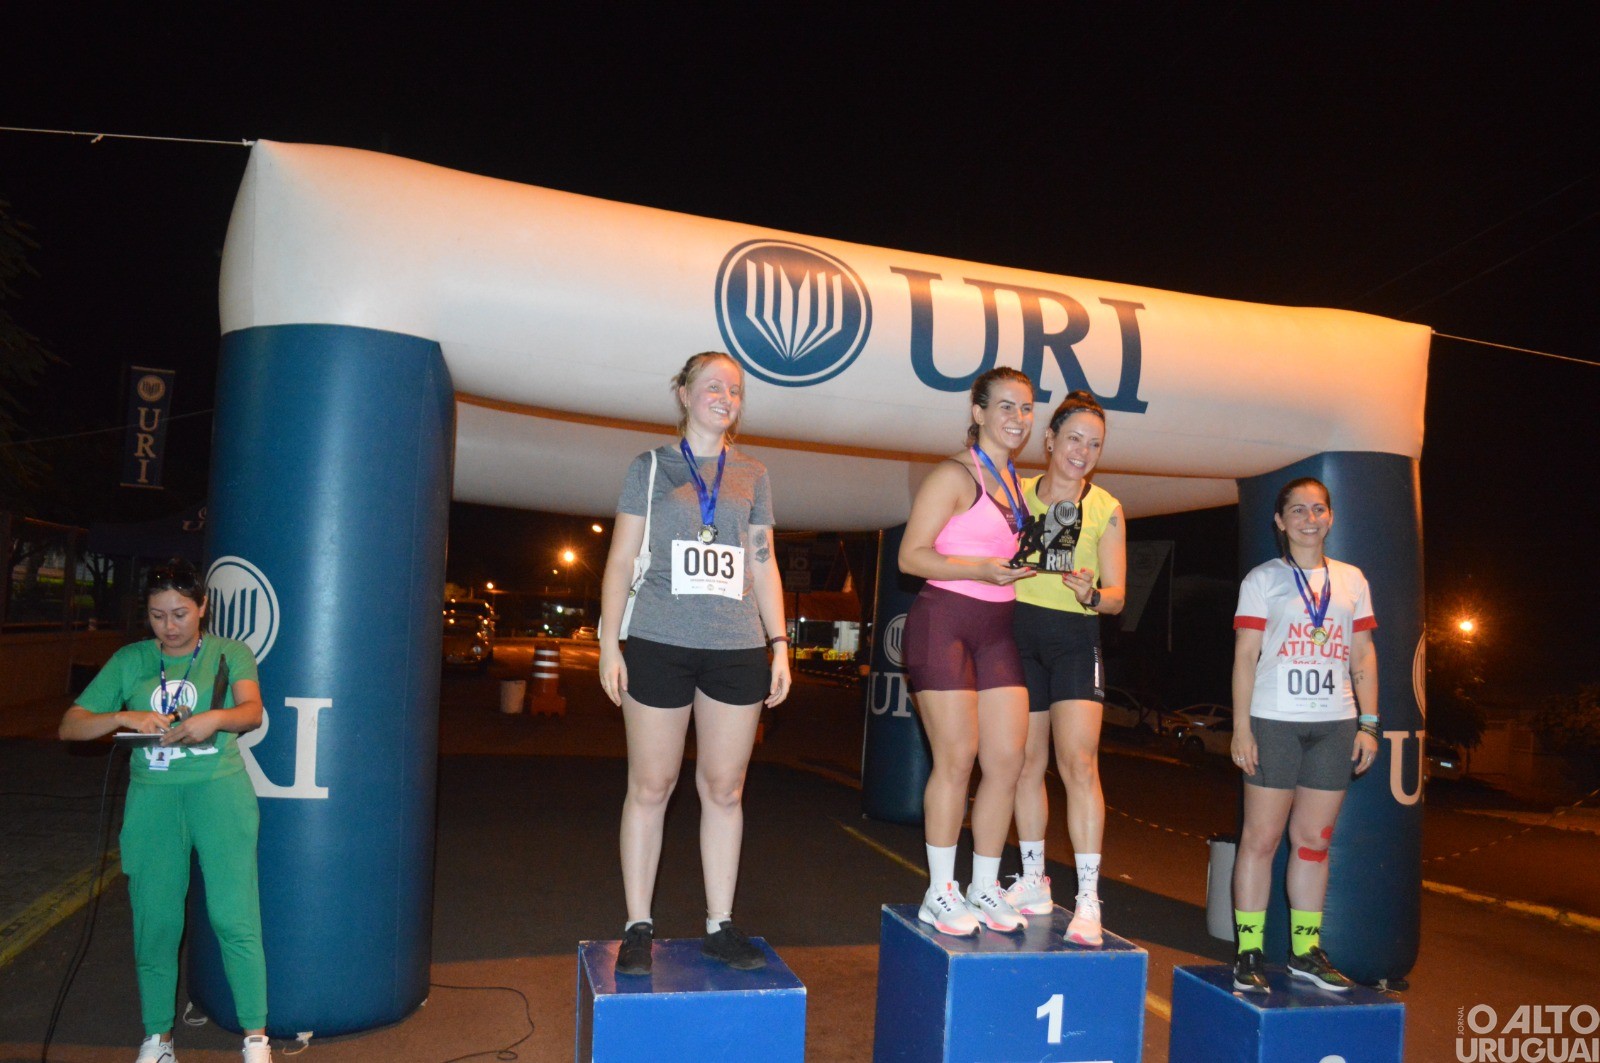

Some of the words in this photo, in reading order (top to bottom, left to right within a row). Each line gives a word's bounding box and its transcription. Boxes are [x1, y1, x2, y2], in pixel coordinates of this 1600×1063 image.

[890, 266, 1148, 414] URI
[134, 407, 162, 483] URI
[684, 547, 734, 579] 003
[1277, 641, 1350, 661] ATITUDE
[1287, 669, 1335, 695] 004
[237, 697, 332, 798] RI
[1294, 925, 1320, 936] 21K
[1036, 994, 1064, 1043] 1
